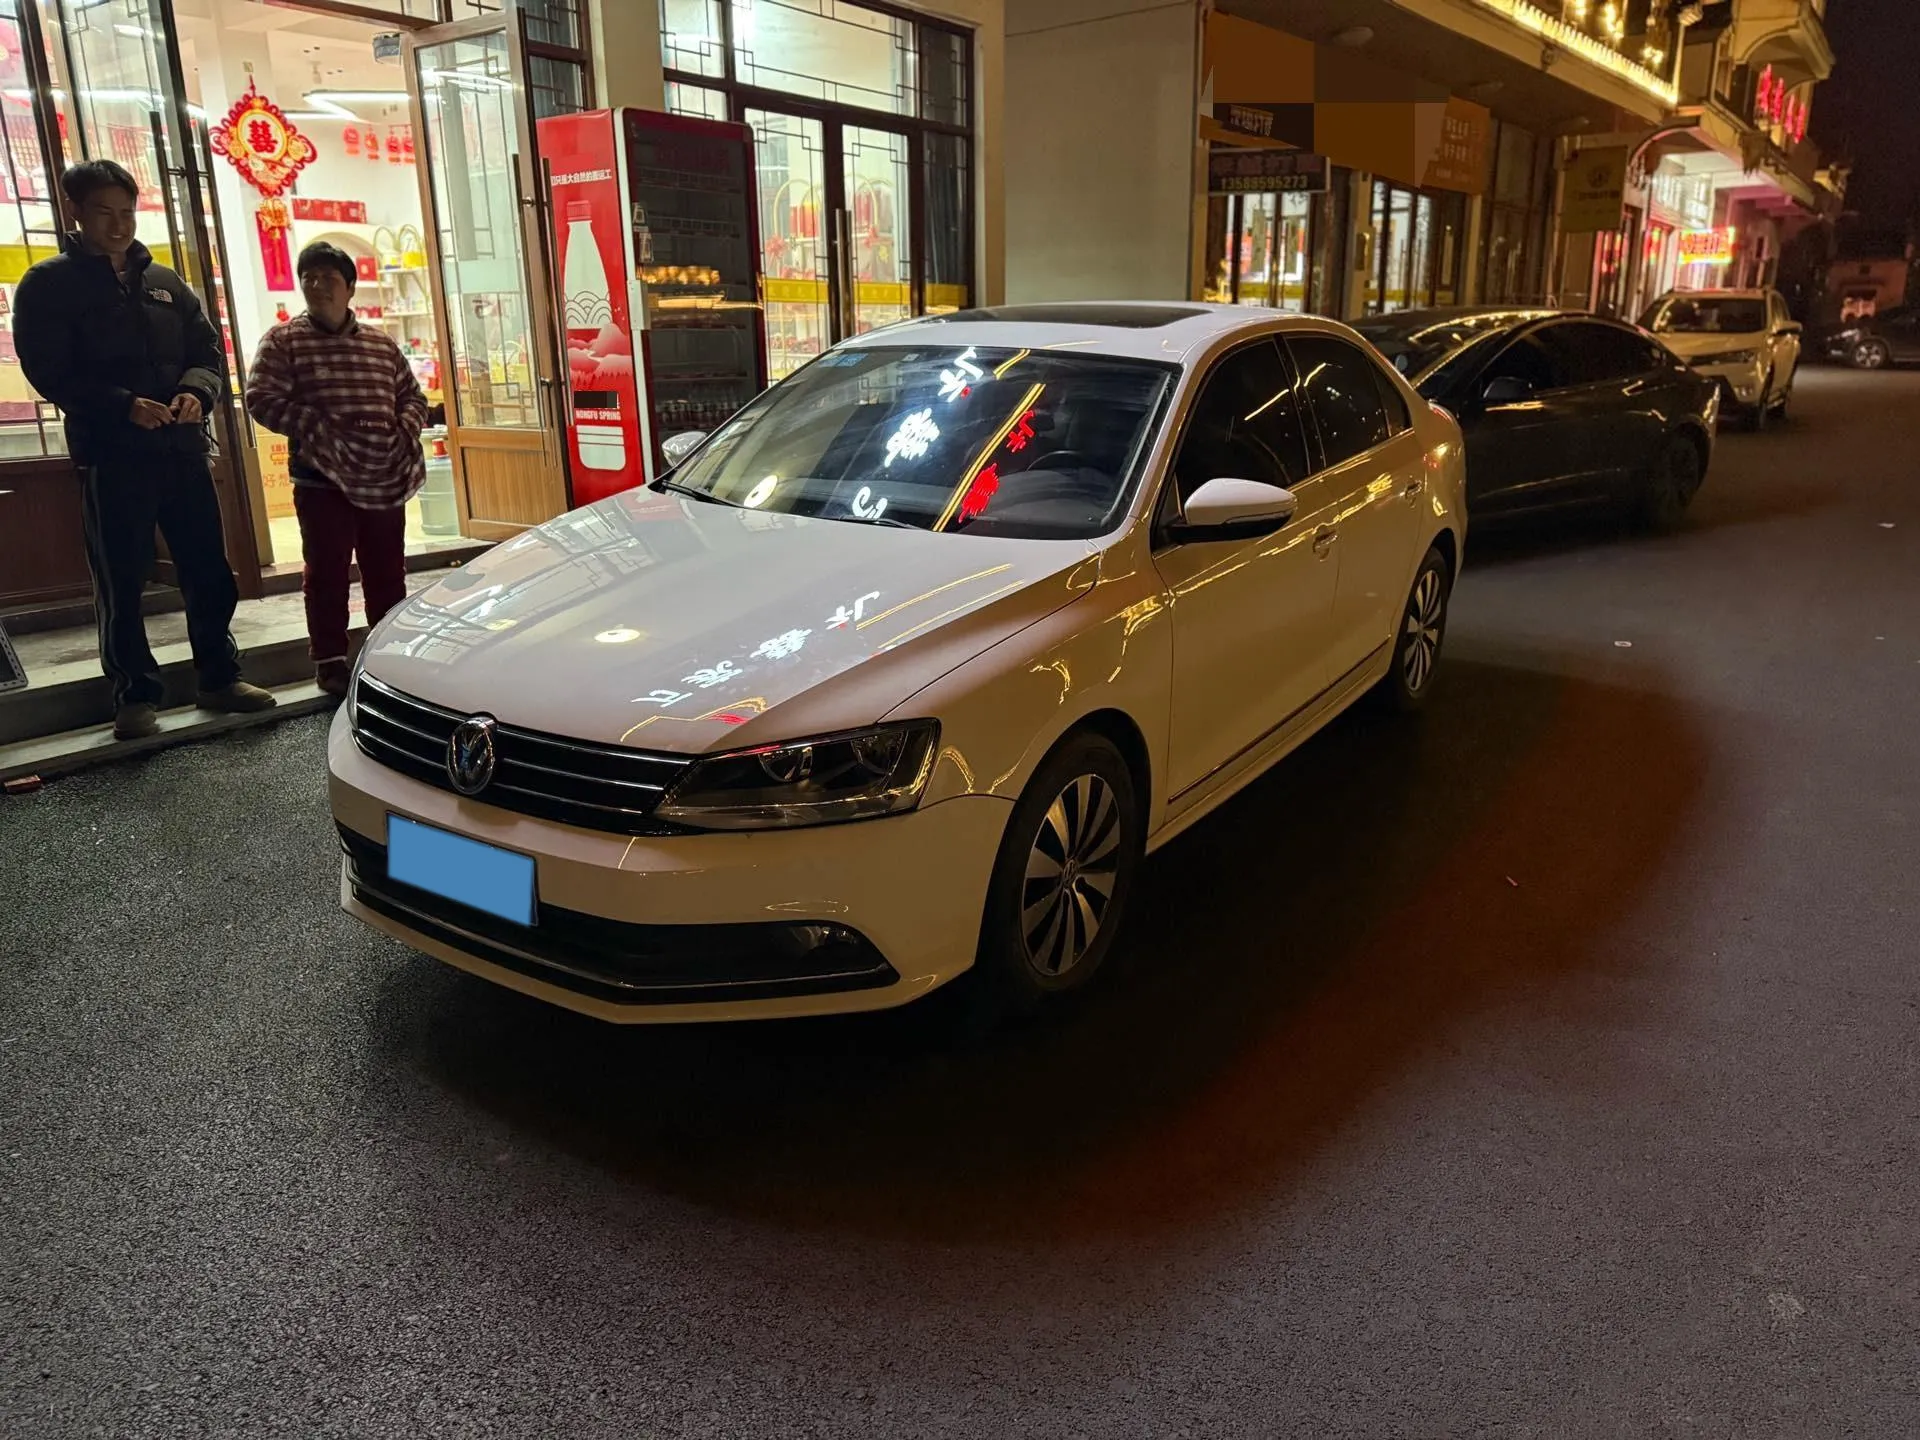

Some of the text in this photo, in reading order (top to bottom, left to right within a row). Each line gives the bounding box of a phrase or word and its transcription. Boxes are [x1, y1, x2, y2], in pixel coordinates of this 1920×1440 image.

[247, 120, 278, 153] 囍
[576, 410, 621, 421] NONGFU SPRING
